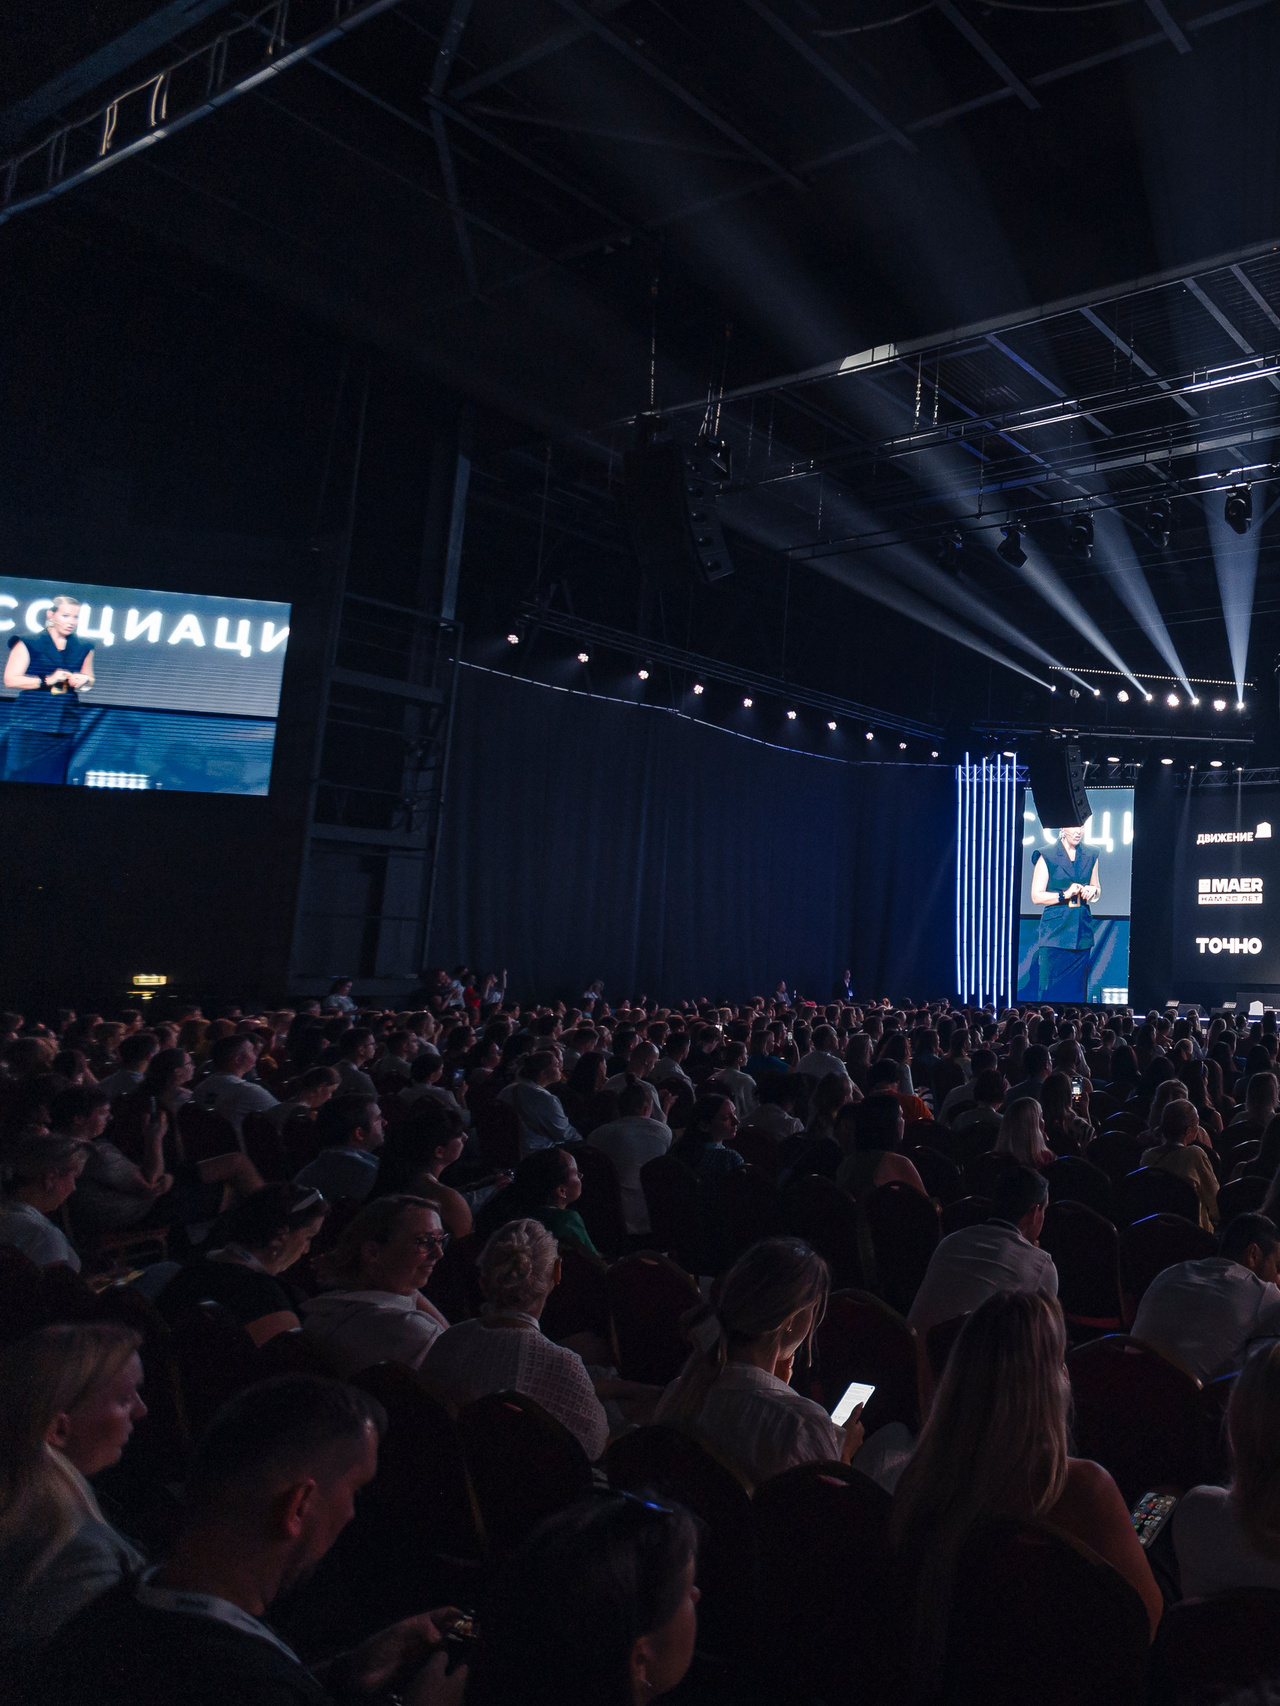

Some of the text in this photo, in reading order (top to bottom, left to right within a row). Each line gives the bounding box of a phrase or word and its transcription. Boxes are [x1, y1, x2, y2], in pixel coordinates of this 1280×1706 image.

[1196, 832, 1254, 845] ДВИЖЕНИЕ
[1211, 877, 1264, 893] MAER
[1195, 937, 1262, 955] ТОЧНО
